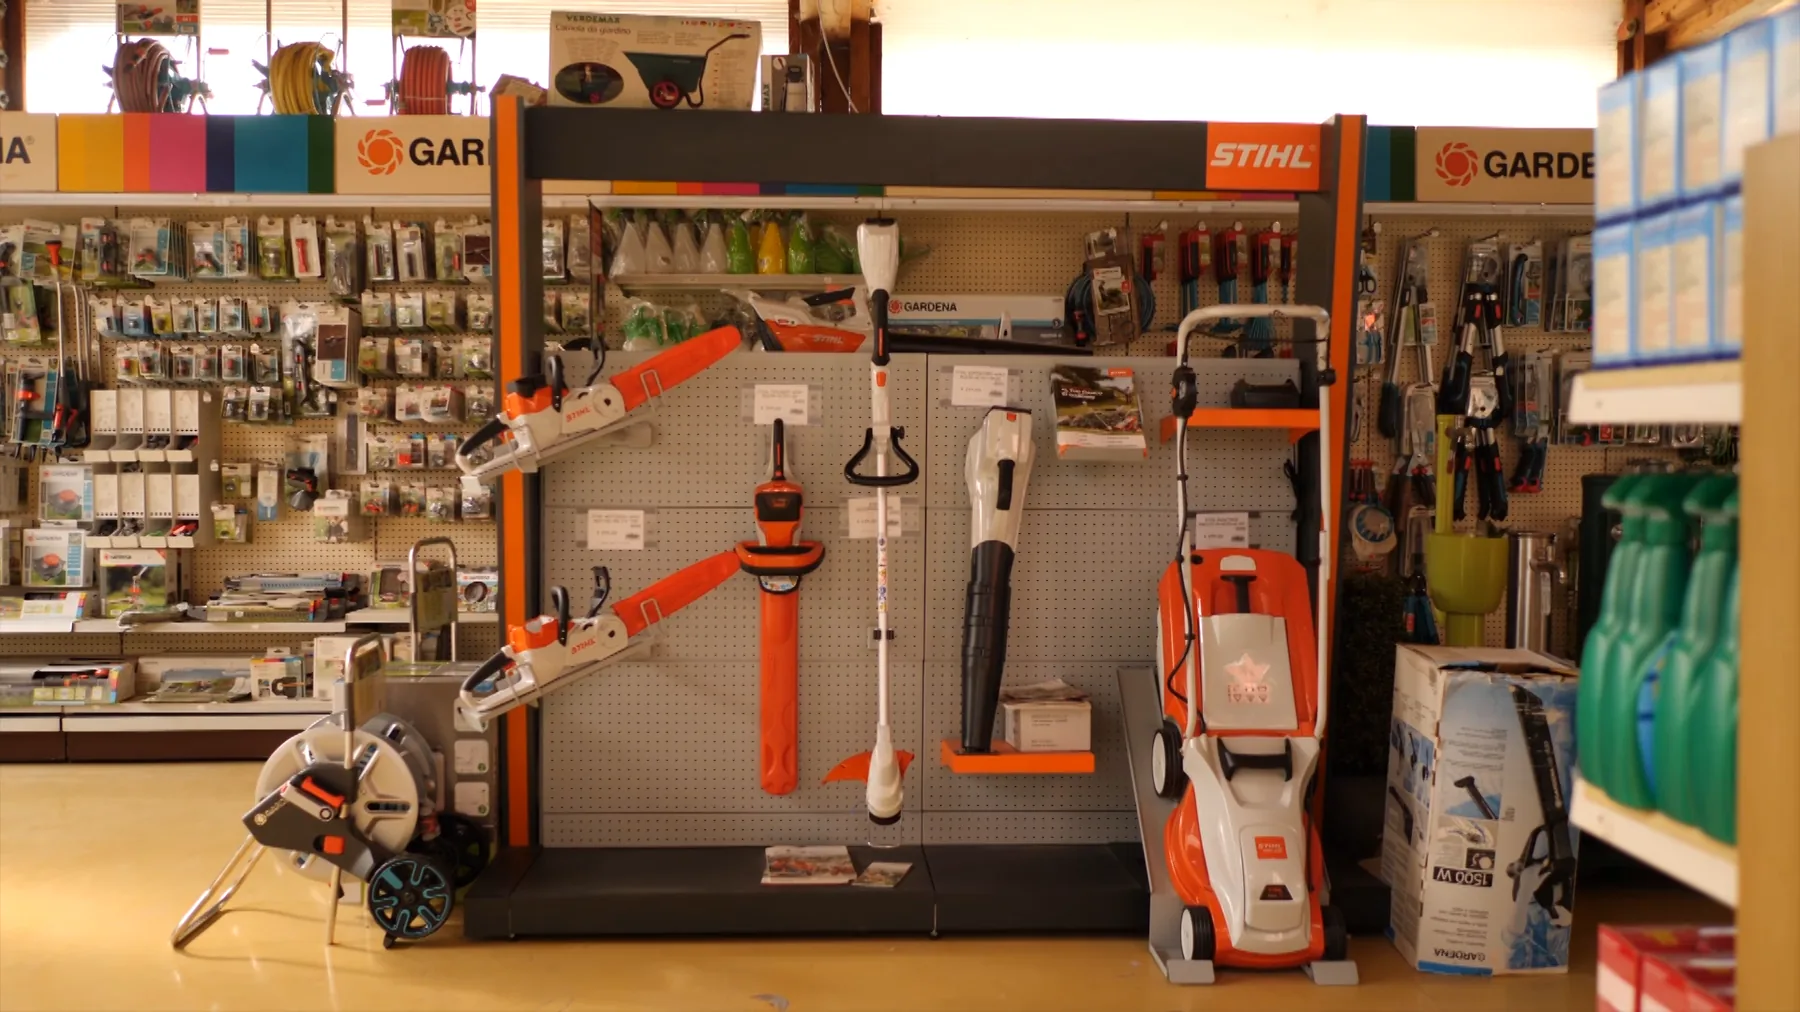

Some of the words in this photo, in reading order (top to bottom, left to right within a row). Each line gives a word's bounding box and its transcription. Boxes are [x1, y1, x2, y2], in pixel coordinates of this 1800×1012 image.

[408, 137, 491, 166] GAR
[1210, 143, 1312, 168] STIHL
[904, 301, 957, 312] GARDENA
[1436, 868, 1452, 881] W
[1455, 871, 1488, 886] 1500
[1433, 948, 1486, 962] GARDENA
